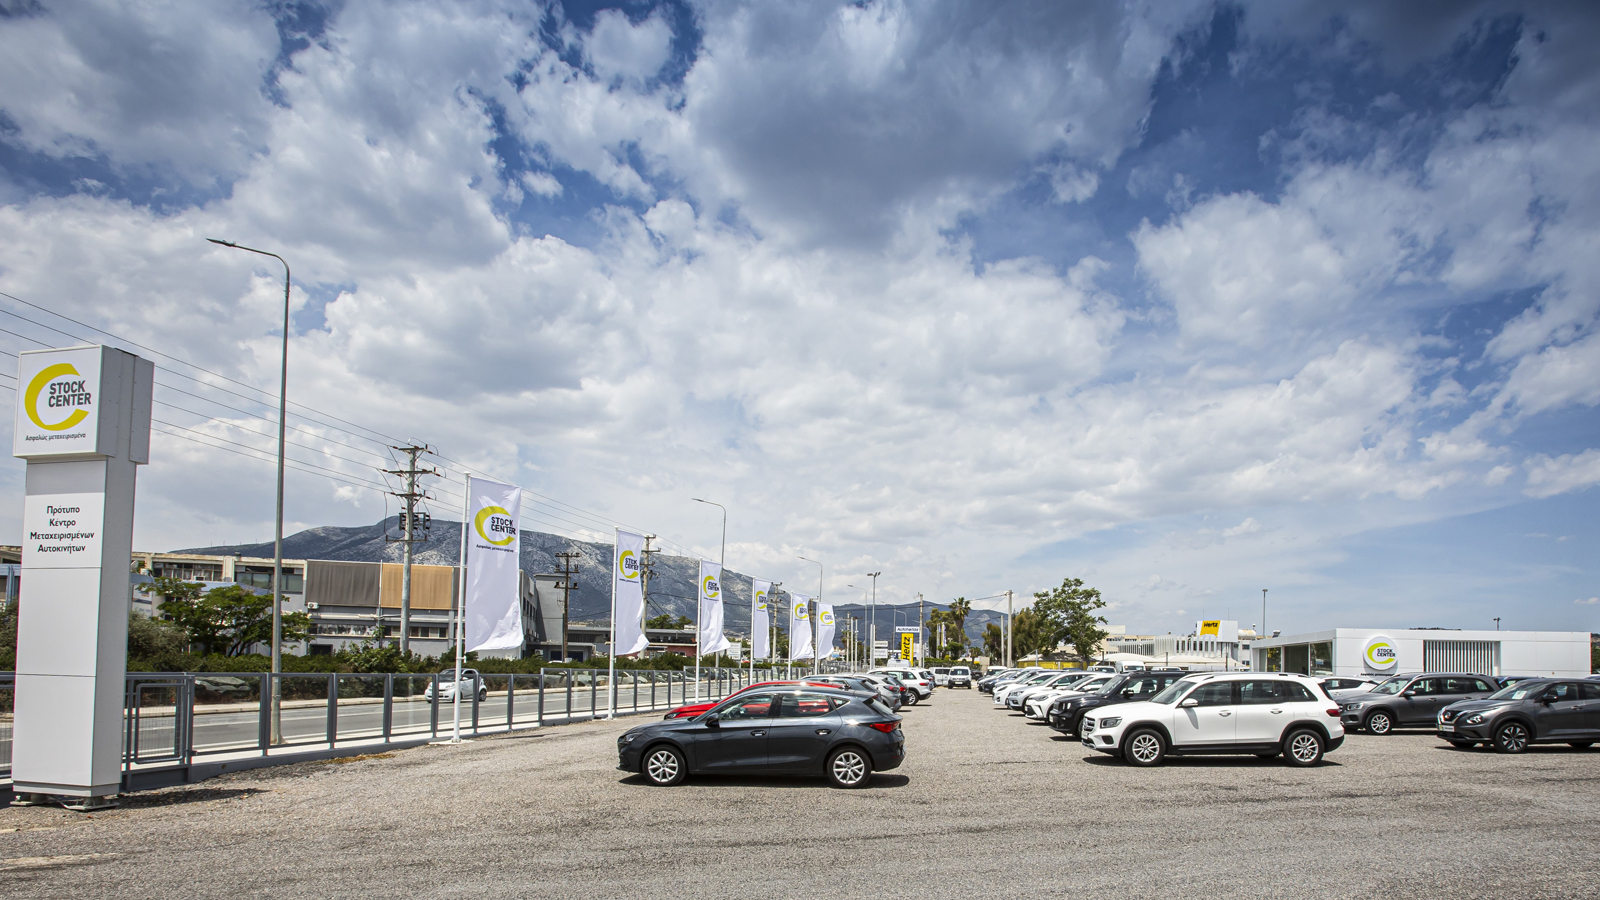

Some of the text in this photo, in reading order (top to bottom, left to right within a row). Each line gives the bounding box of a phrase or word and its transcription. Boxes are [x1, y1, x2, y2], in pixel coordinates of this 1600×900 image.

[49, 380, 86, 395] STOCK
[48, 392, 92, 408] CENTER
[25, 433, 48, 442] Ασφαλώς
[46, 505, 80, 516] Πρότυπο
[49, 517, 77, 528] Κέντρο
[491, 516, 514, 527] STOCK
[490, 524, 516, 535] CENTER
[30, 530, 95, 541] Μεταχειρισμένων
[37, 543, 86, 554] Αυτοκινήτων
[902, 636, 911, 660] Hertz
